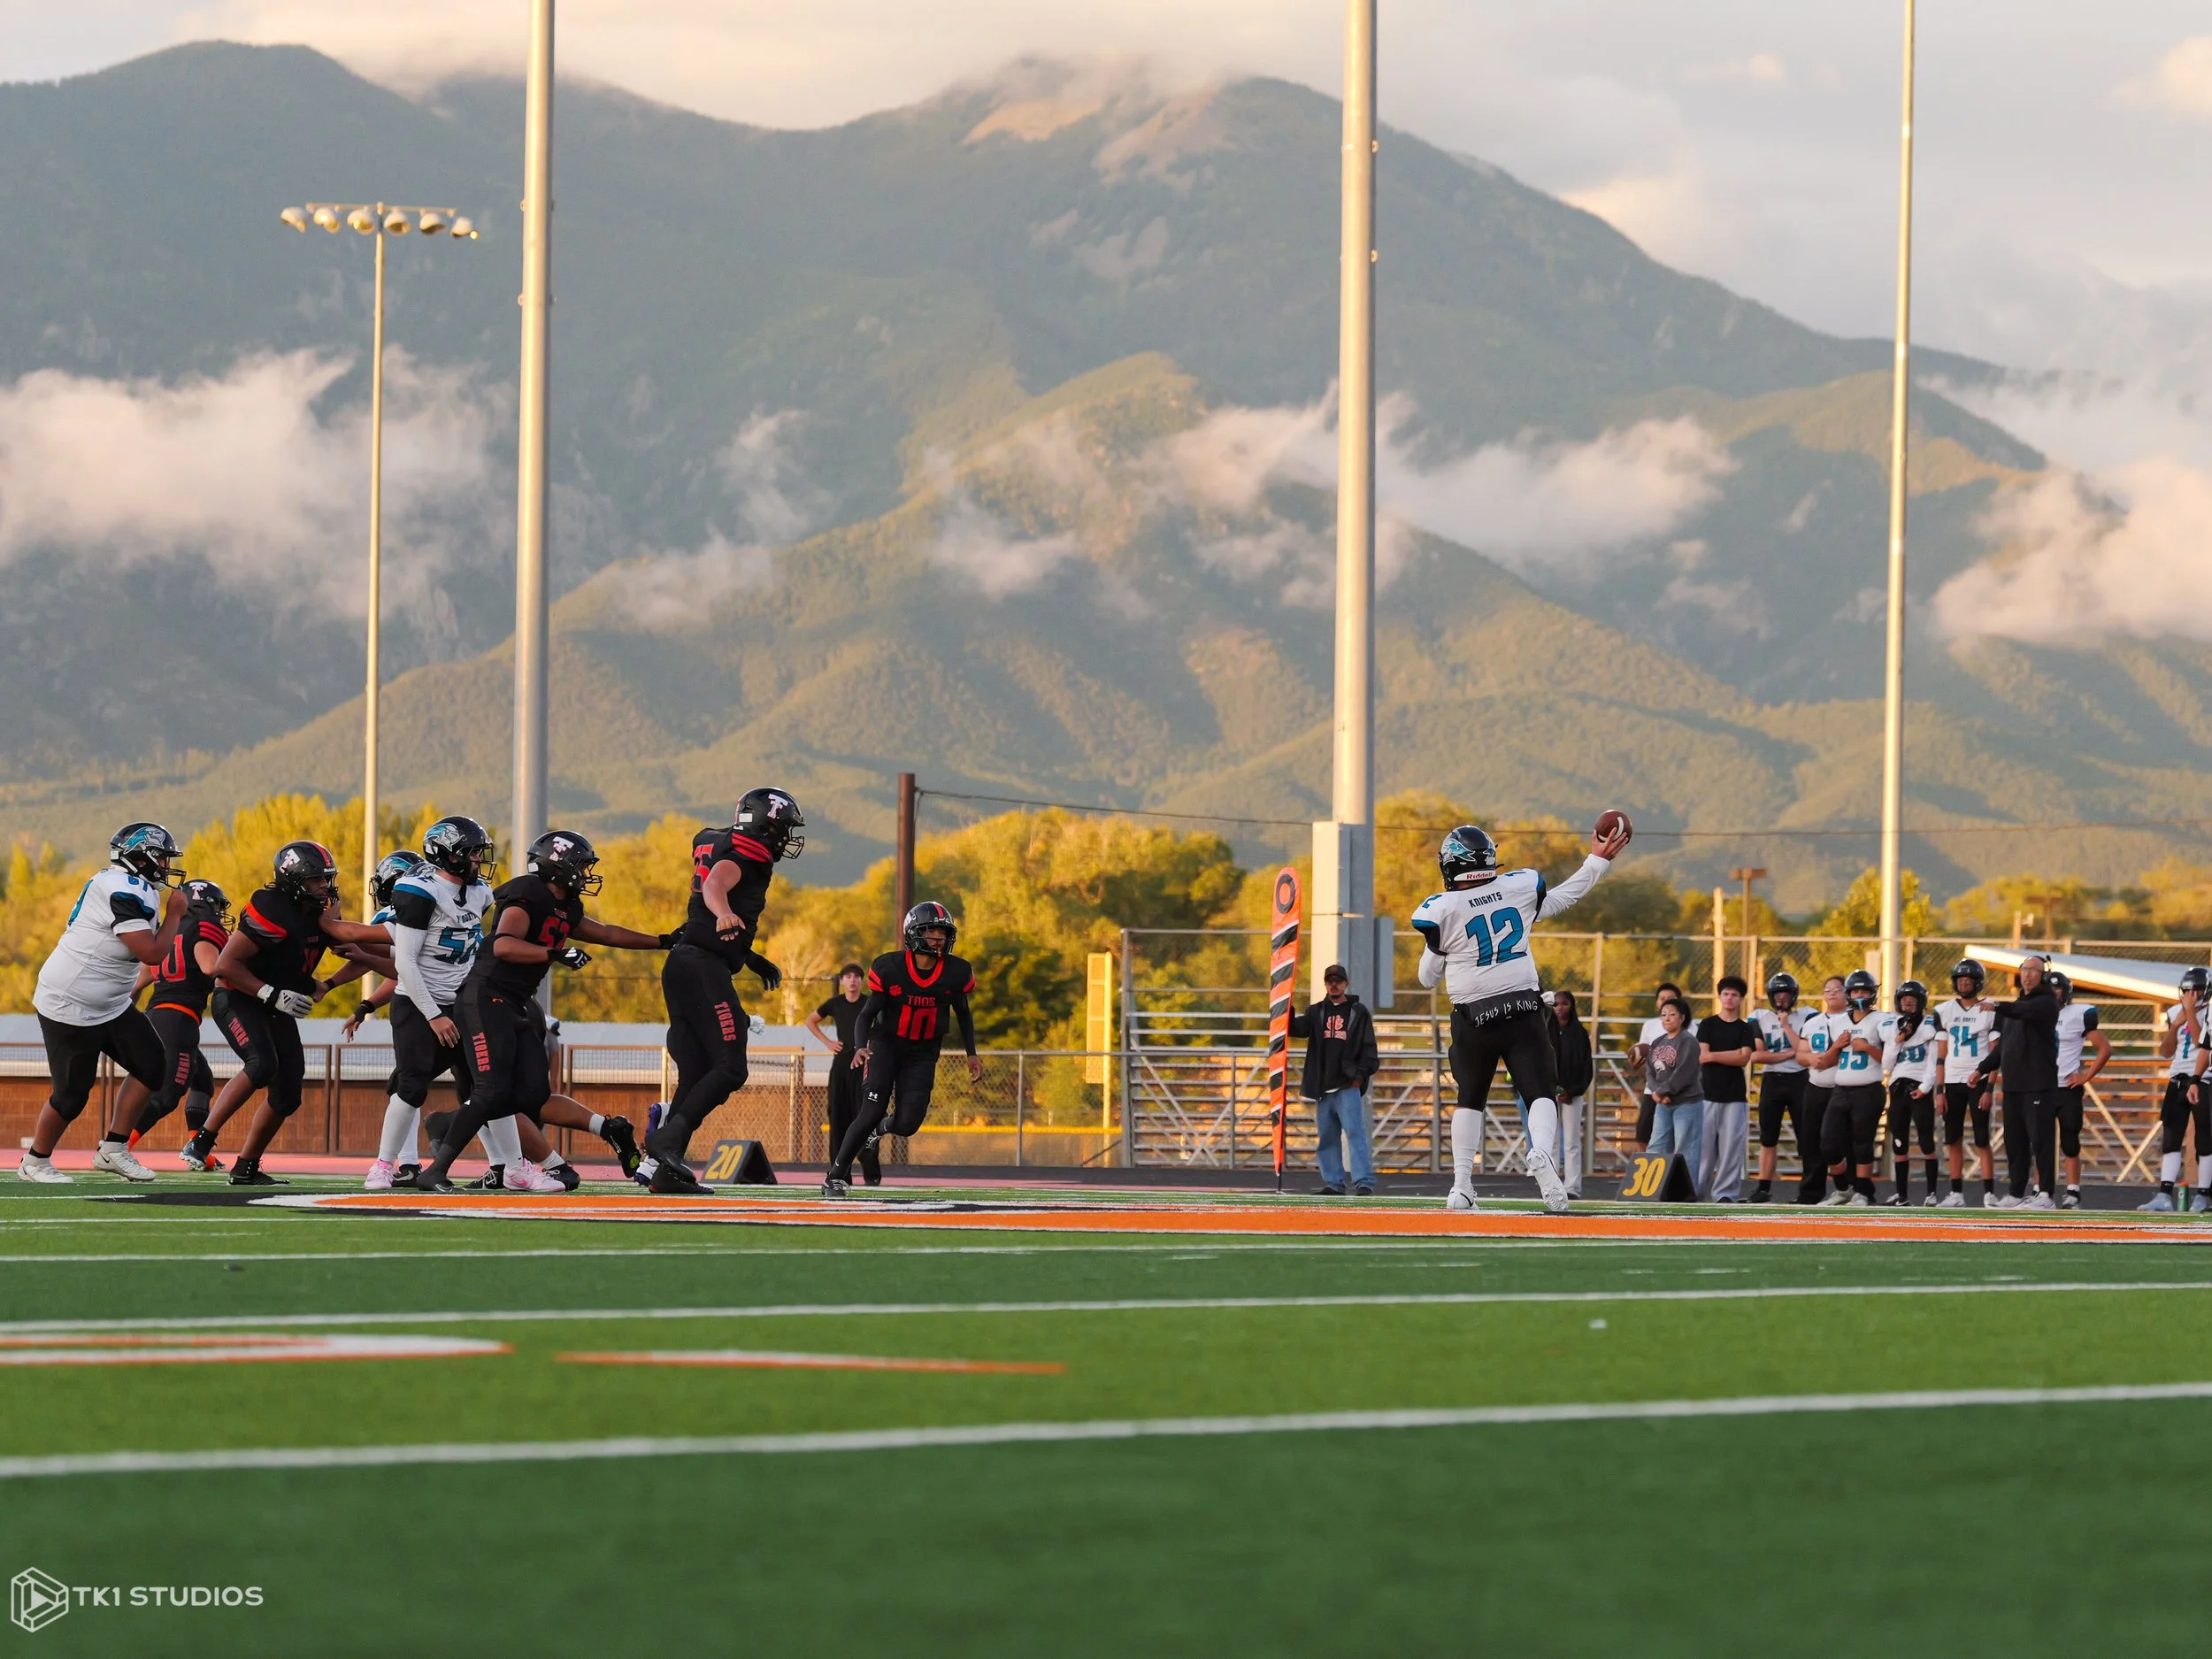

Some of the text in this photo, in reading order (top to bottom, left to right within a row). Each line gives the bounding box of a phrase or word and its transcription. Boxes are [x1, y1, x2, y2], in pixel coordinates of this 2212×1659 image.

[1468, 891, 1503, 909] KNIGHTS
[1464, 906, 1527, 967] 12
[906, 995, 936, 1007] TAOS
[1474, 999, 1539, 1028] JESUS IS KING
[714, 1001, 737, 1041] TIGERS
[895, 1004, 938, 1041] 10
[472, 1032, 491, 1072] TIGERS
[1949, 1025, 1978, 1057] 14
[704, 1144, 743, 1180] 20
[1622, 1156, 1666, 1197] 30
